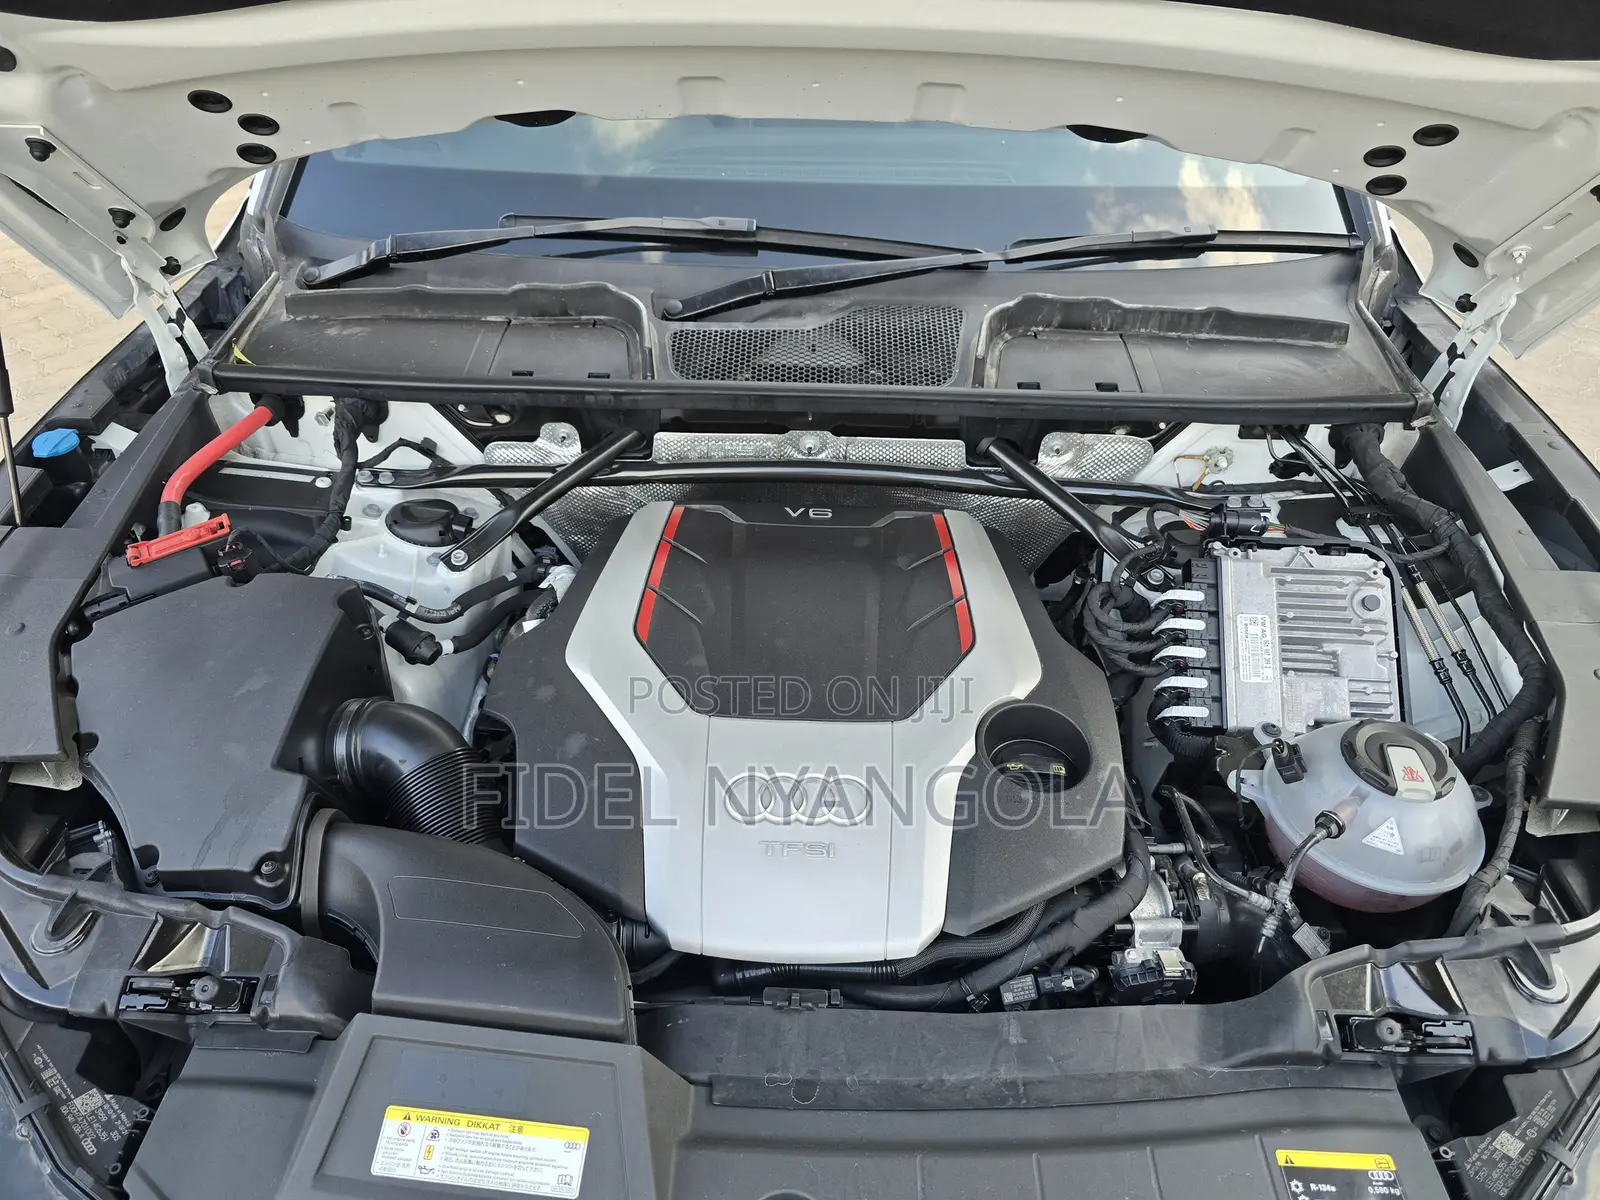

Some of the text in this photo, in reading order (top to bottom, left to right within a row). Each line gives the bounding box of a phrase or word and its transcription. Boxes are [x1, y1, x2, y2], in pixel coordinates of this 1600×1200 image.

[784, 506, 833, 519] V6
[758, 840, 836, 858] TFSI
[416, 1113, 462, 1127] WARNING
[466, 1120, 501, 1132] DIKKAT
[508, 1124, 524, 1135] 注意
[1309, 1183, 1336, 1192] R-134a
[1390, 1187, 1400, 1196] kg
